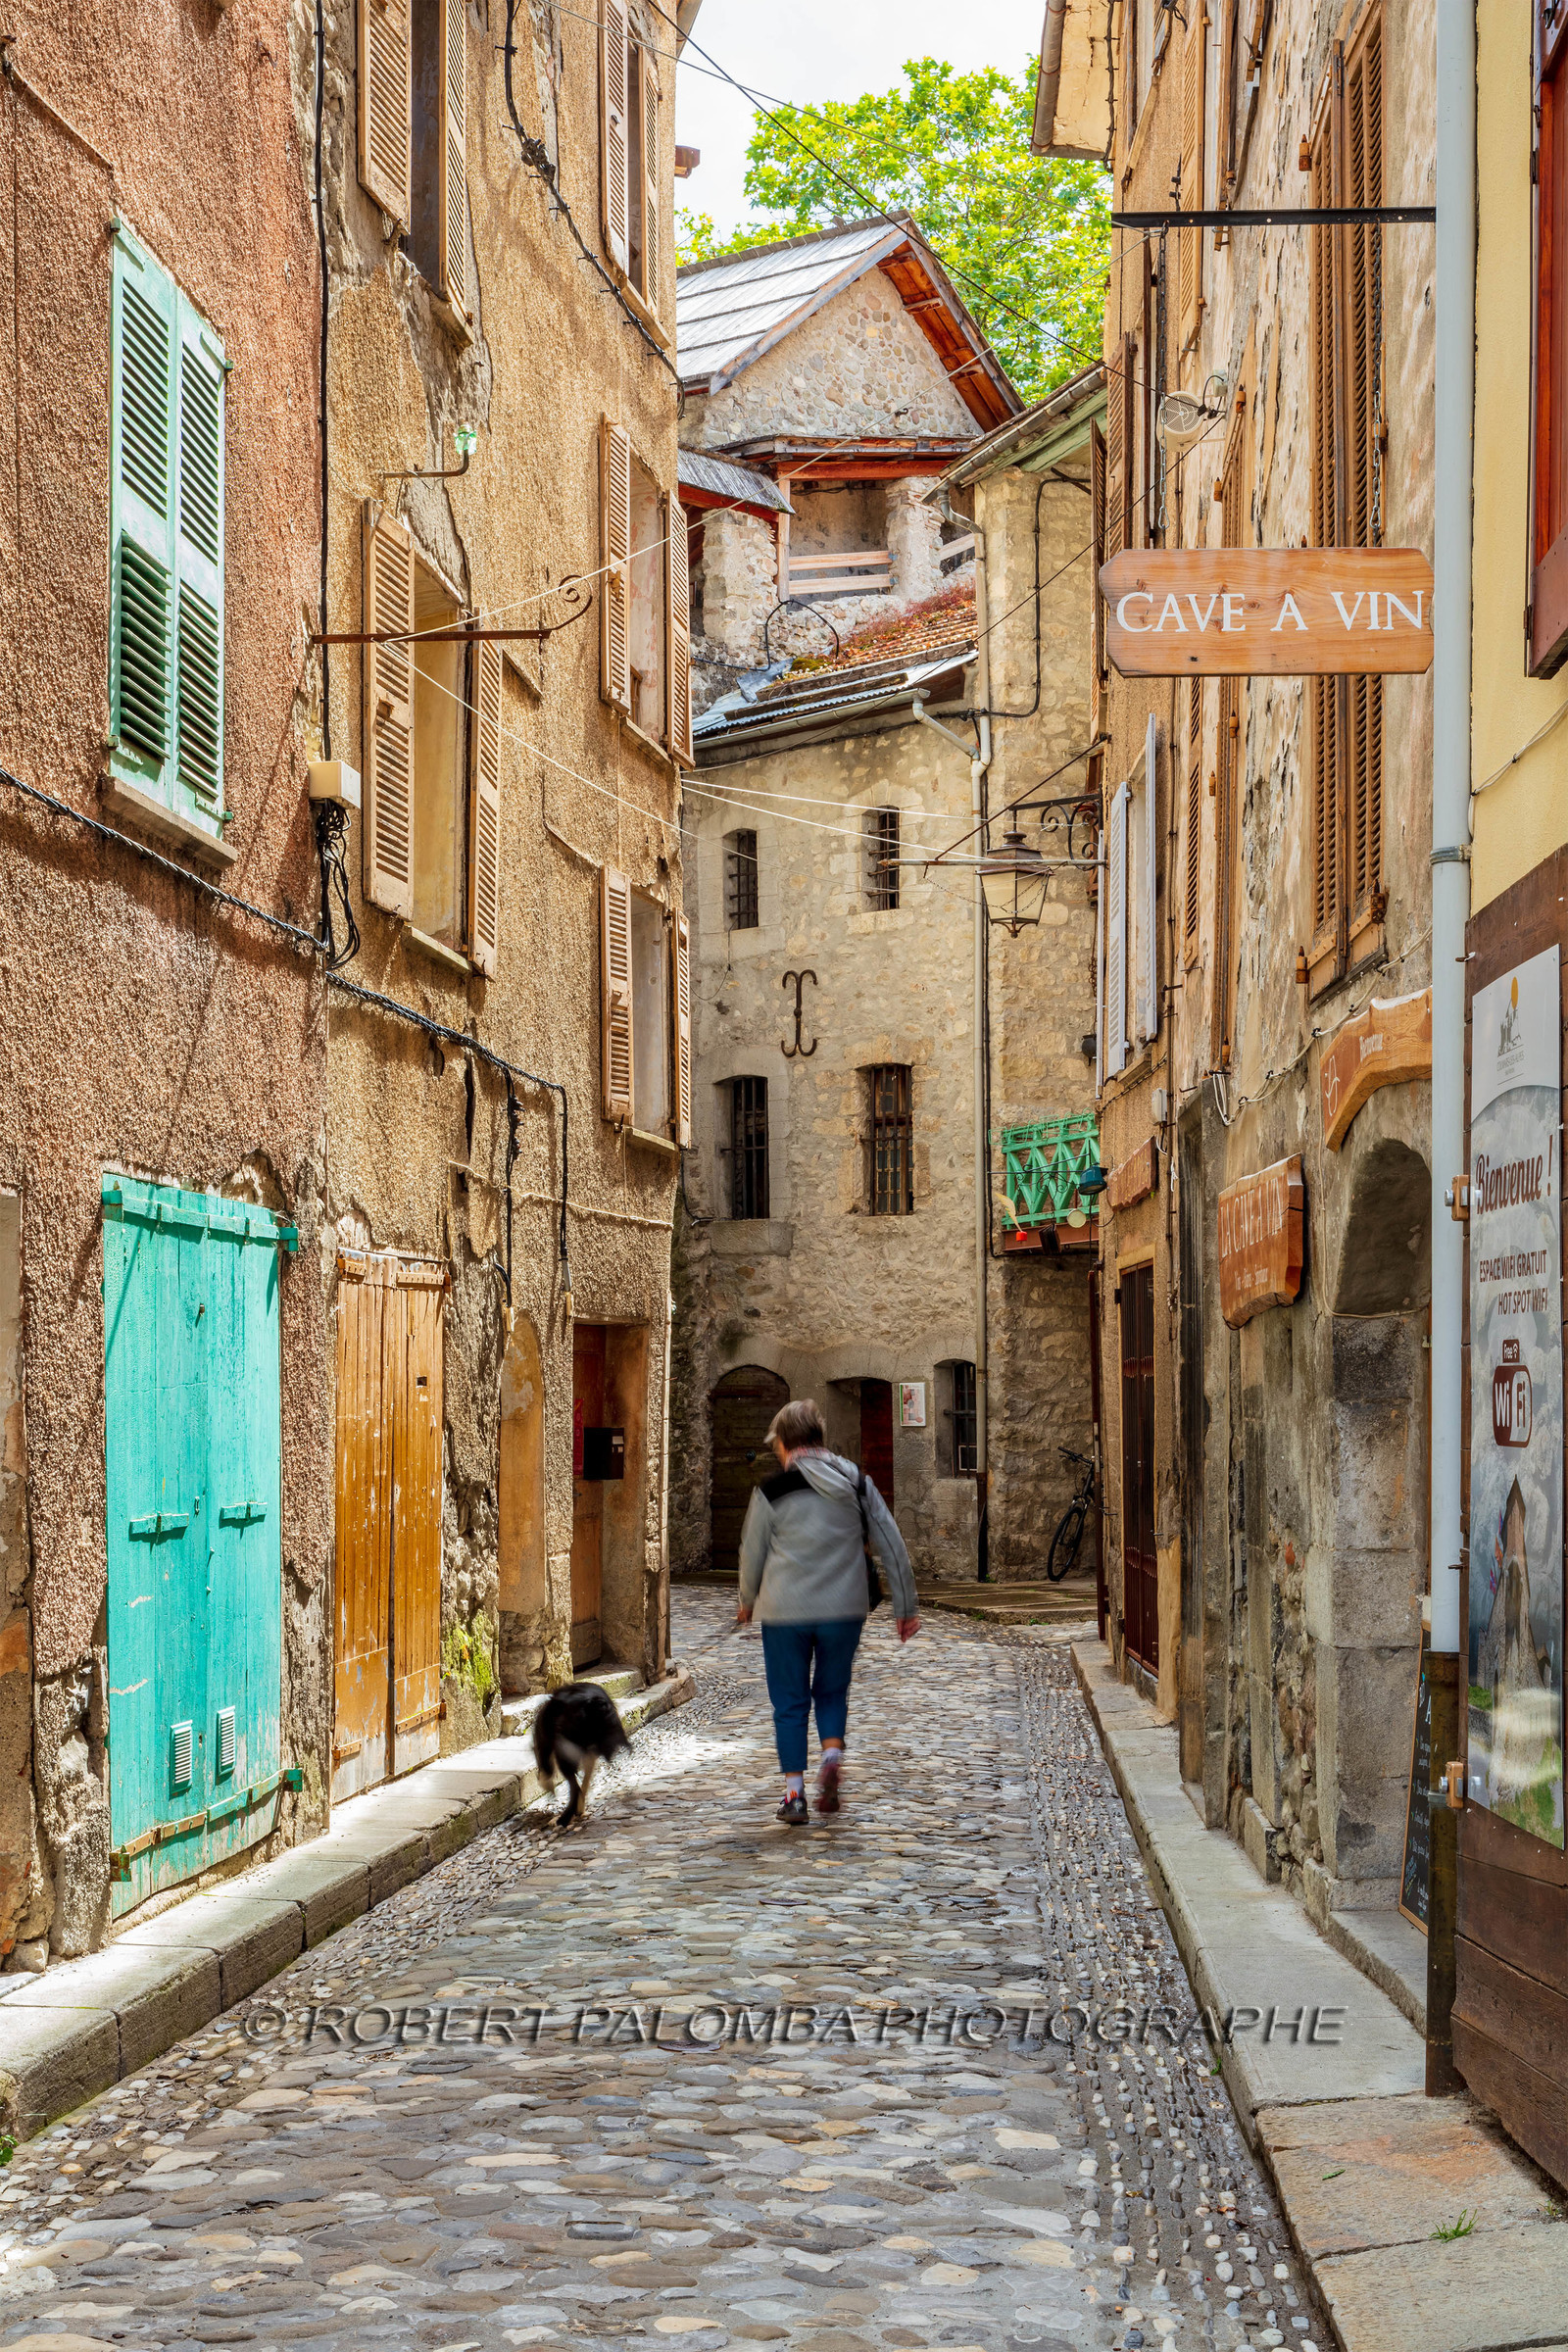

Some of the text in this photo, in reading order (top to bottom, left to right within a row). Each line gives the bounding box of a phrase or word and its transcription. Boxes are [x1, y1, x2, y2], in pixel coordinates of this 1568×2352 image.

[1116, 590, 1425, 633] CAVE A VIN
[1220, 1172, 1285, 1258] LA CAVE A VIN
[1480, 1249, 1547, 1283] ESPACE WIFI GRATUIT
[1497, 1287, 1548, 1315] HOT SPOT WIFI
